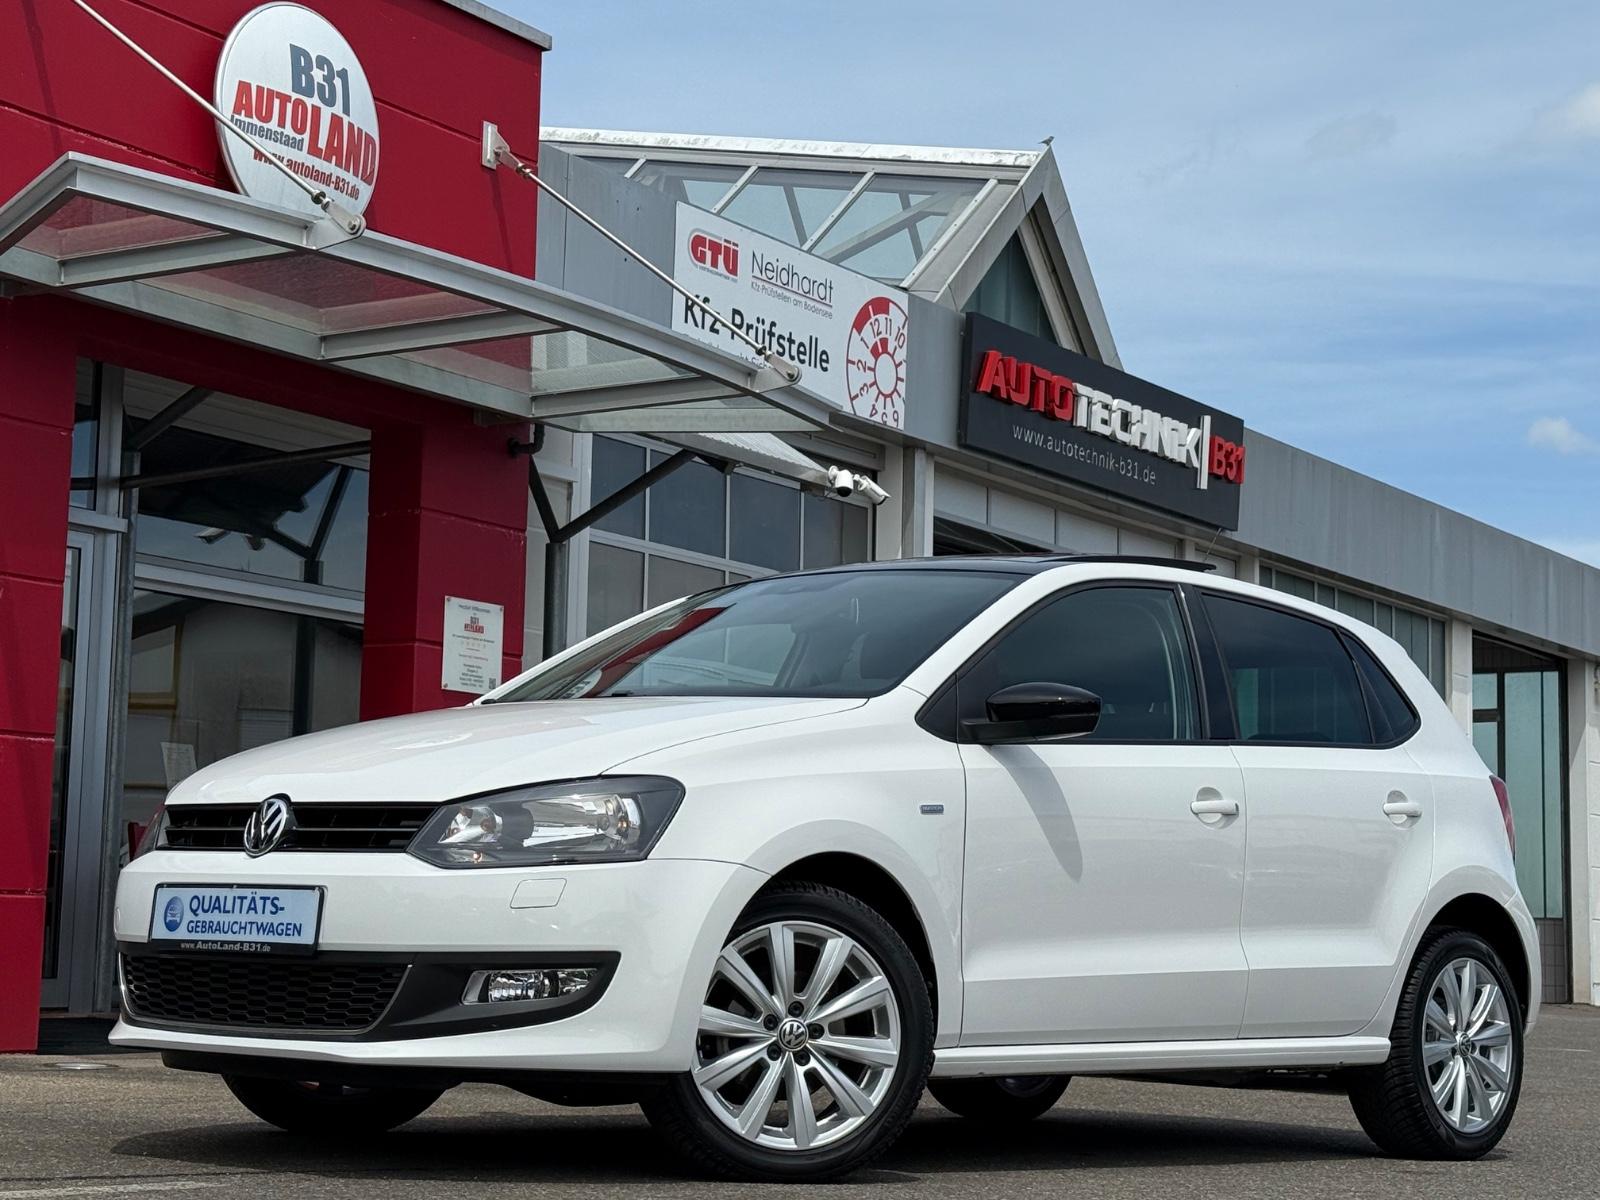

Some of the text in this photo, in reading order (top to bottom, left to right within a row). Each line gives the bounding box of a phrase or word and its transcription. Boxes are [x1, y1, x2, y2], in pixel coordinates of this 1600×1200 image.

[289, 43, 350, 117] B31
[233, 80, 376, 186] AUTOLAND
[253, 147, 360, 201] wwautoland-B31.de
[691, 234, 739, 277] GTÜ
[752, 250, 834, 303] Neidhardt
[804, 301, 833, 319] Bodensee
[1012, 424, 1156, 485] www.autotechnik-b31.de
[187, 920, 302, 937] GEBRAUCHTWAGEN
[189, 892, 285, 917] QUALITÄTS-
